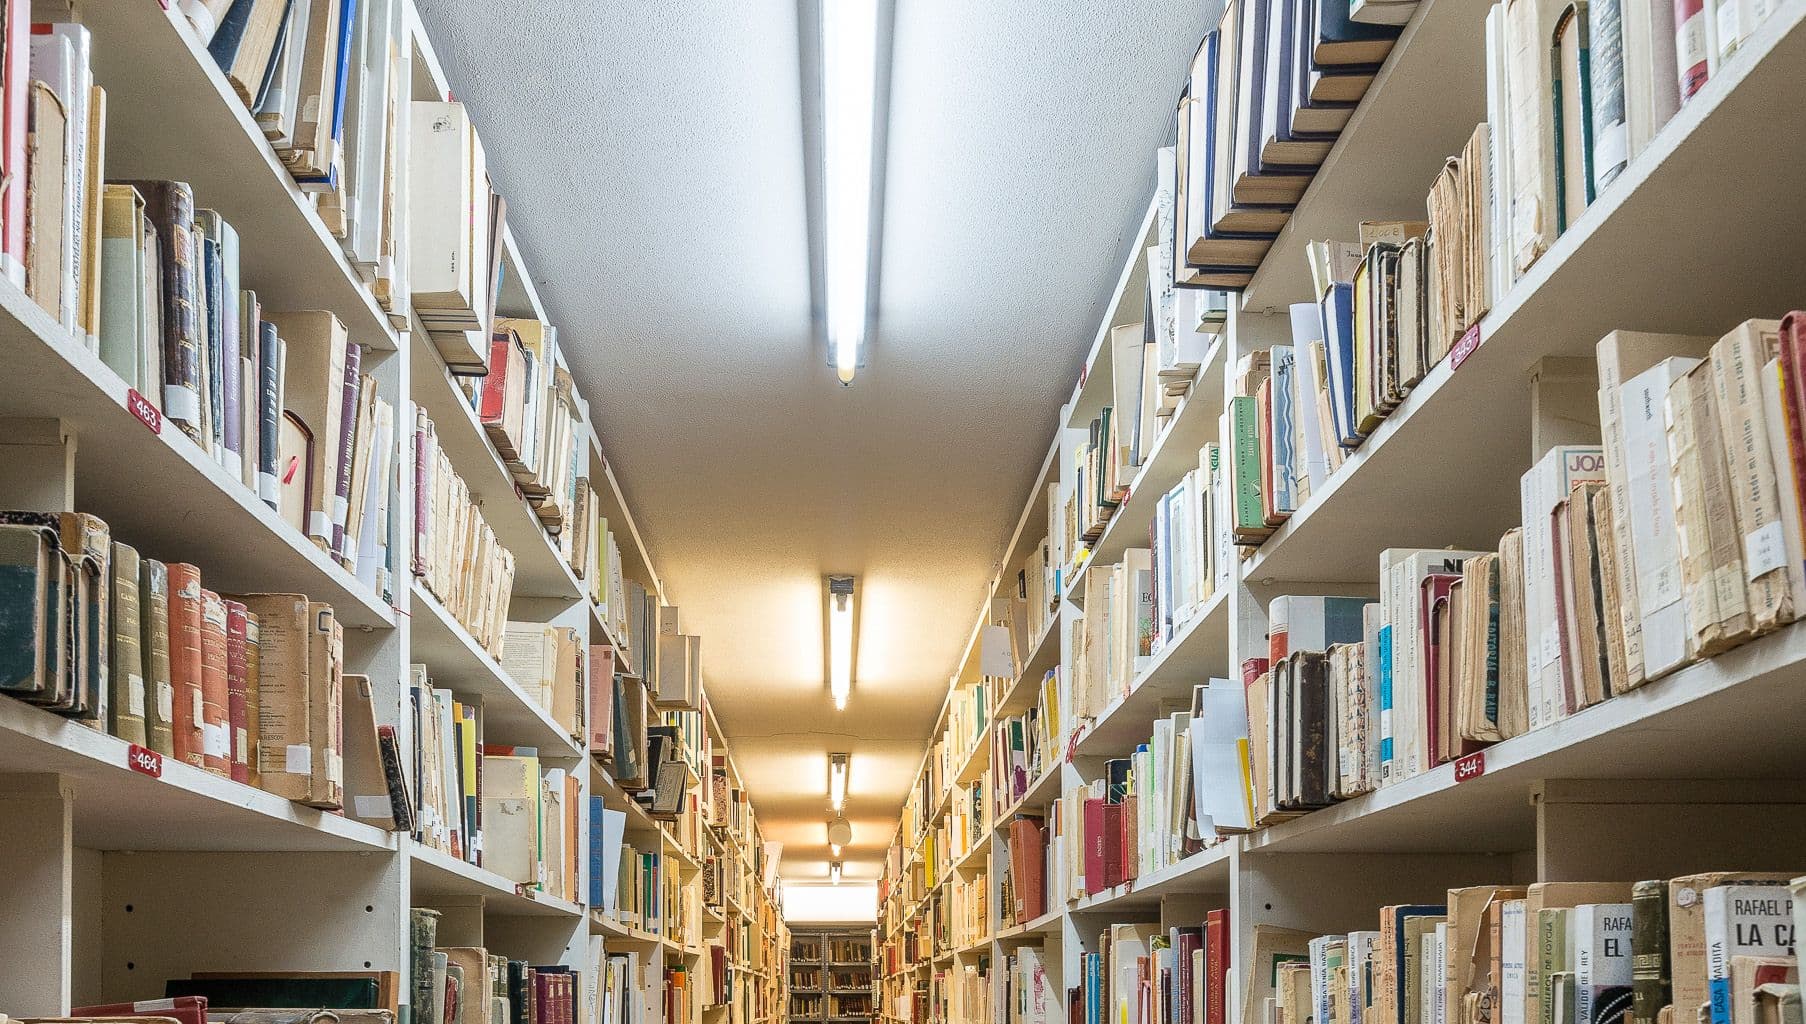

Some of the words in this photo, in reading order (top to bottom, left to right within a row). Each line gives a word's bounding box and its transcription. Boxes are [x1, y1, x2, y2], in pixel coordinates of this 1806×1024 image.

[136, 400, 158, 427] 463
[137, 755, 158, 770] 464
[1459, 760, 1477, 777] 344
[1735, 899, 1781, 916] RAFAEL
[1604, 917, 1632, 931] RAFA
[1545, 922, 1553, 955] LOYOLA
[1736, 923, 1763, 946] LA
[1604, 938, 1624, 957] EL
[1545, 959, 1552, 970] DE
[1713, 941, 1723, 983] MALDITA
[1715, 989, 1726, 1014] CASA
